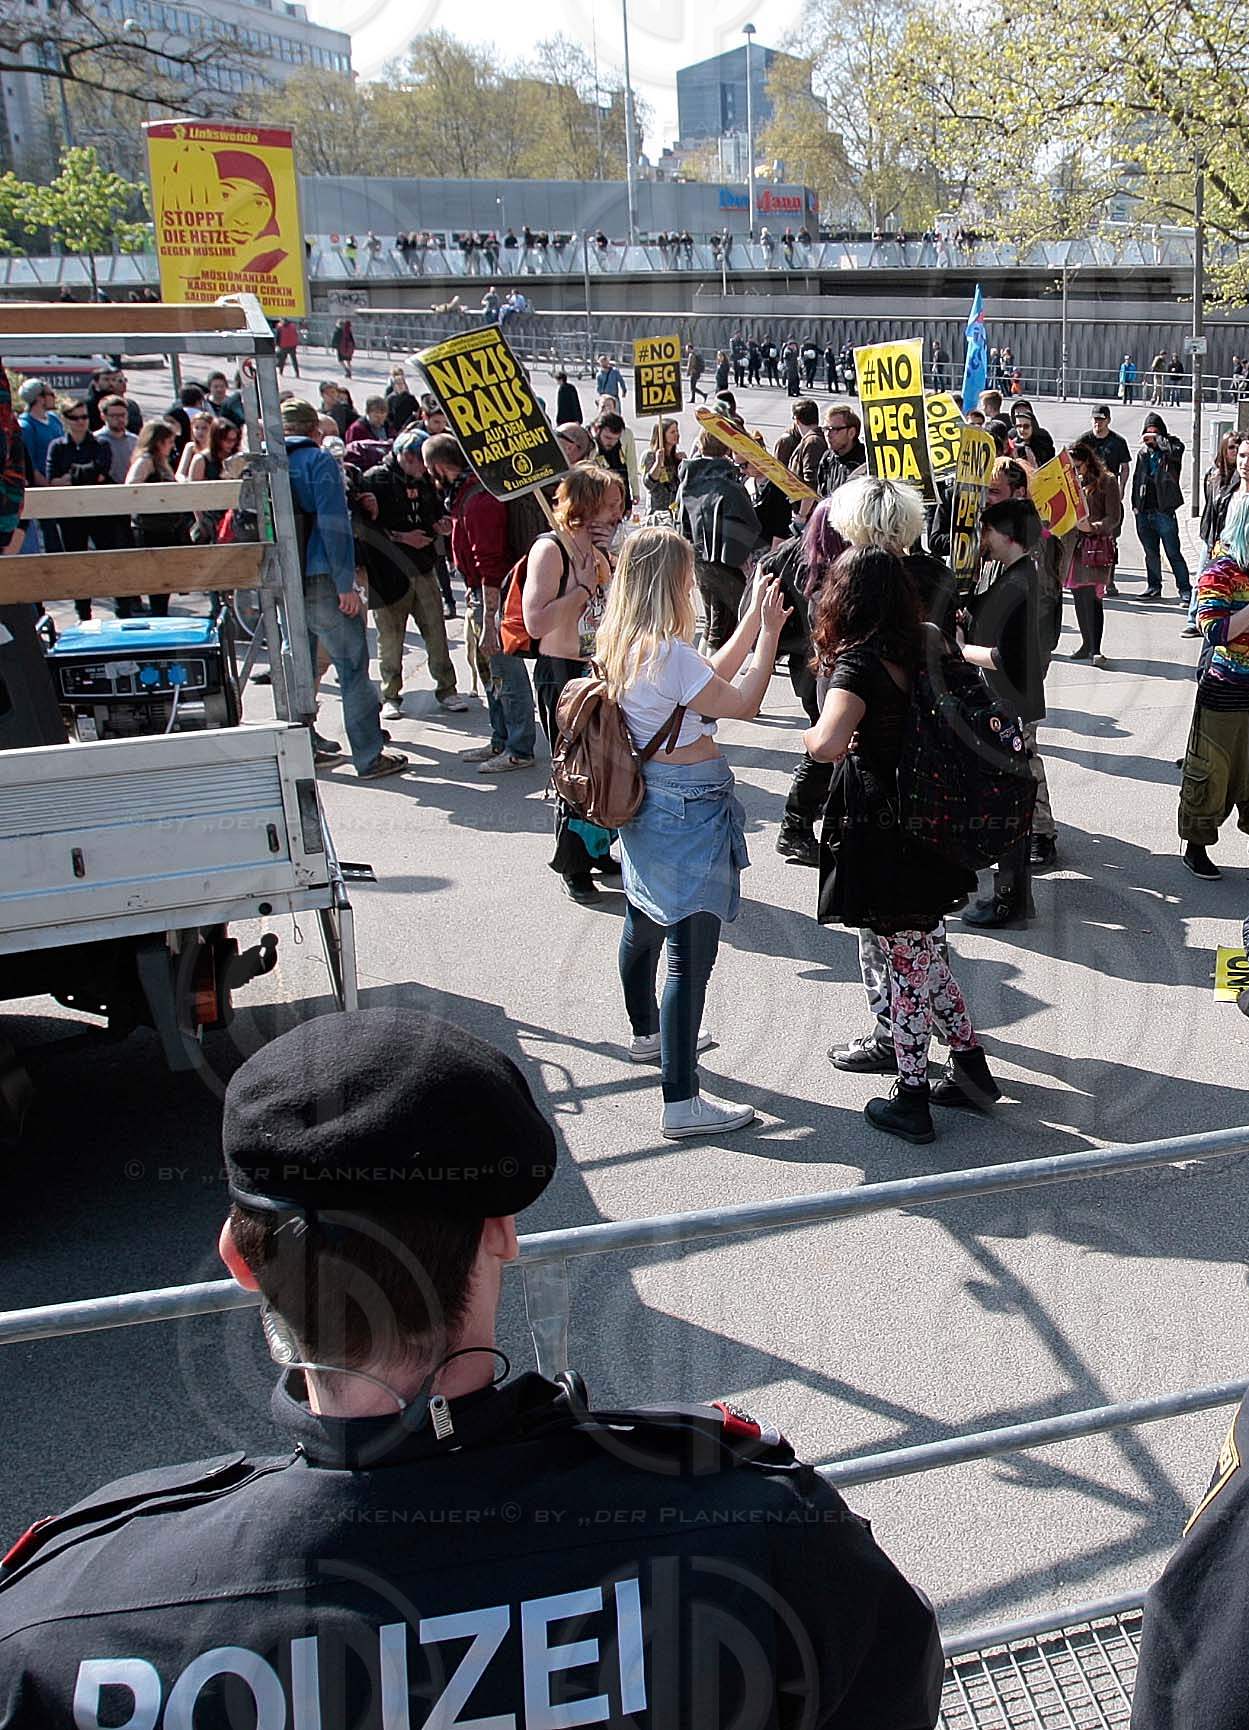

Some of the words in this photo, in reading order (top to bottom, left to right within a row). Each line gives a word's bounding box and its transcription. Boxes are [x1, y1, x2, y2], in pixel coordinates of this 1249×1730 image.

[164, 211, 224, 227] STOPPT
[163, 229, 186, 243] DIE
[189, 230, 231, 245] HETZE
[160, 247, 191, 256] GEGEN
[193, 247, 236, 257] MUSLIME
[639, 342, 675, 362] #NO
[427, 343, 516, 399] NAZIS
[640, 366, 676, 384] PEG
[863, 354, 912, 395] #NO
[447, 377, 534, 437] RAUS
[642, 386, 676, 405] IDA
[484, 425, 506, 444] AUS
[503, 421, 527, 438] DEM
[869, 403, 918, 442] PEG
[471, 427, 549, 467] PARLAMENT
[875, 443, 922, 480] IDA
